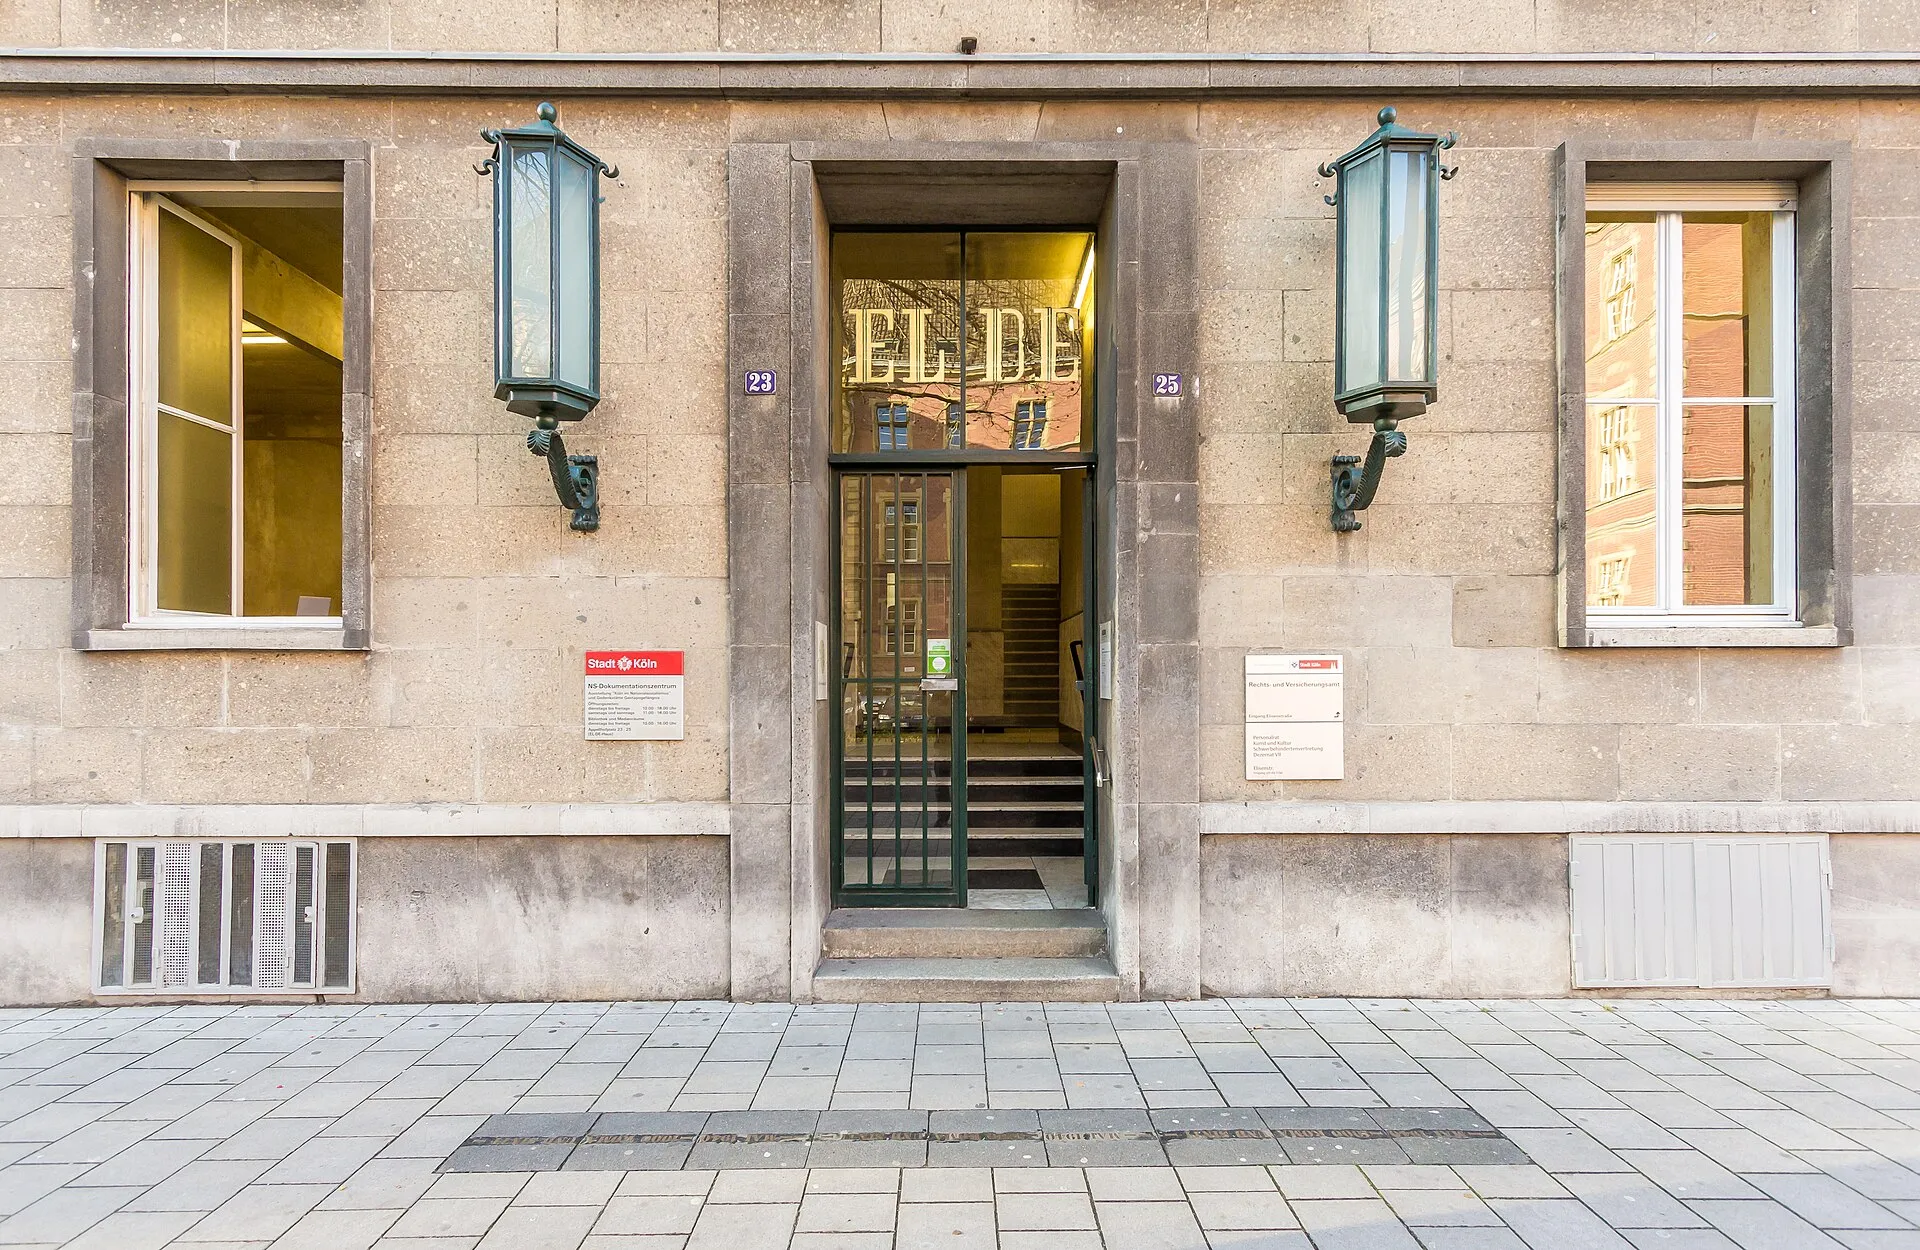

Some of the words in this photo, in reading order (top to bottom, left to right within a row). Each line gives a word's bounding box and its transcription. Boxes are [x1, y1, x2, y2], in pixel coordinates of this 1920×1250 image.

[849, 309, 945, 382] EL
[979, 309, 1079, 382] DE
[749, 373, 772, 391] 23
[1156, 375, 1179, 394] 25
[587, 658, 615, 668] Stadt
[633, 658, 657, 668] Köln
